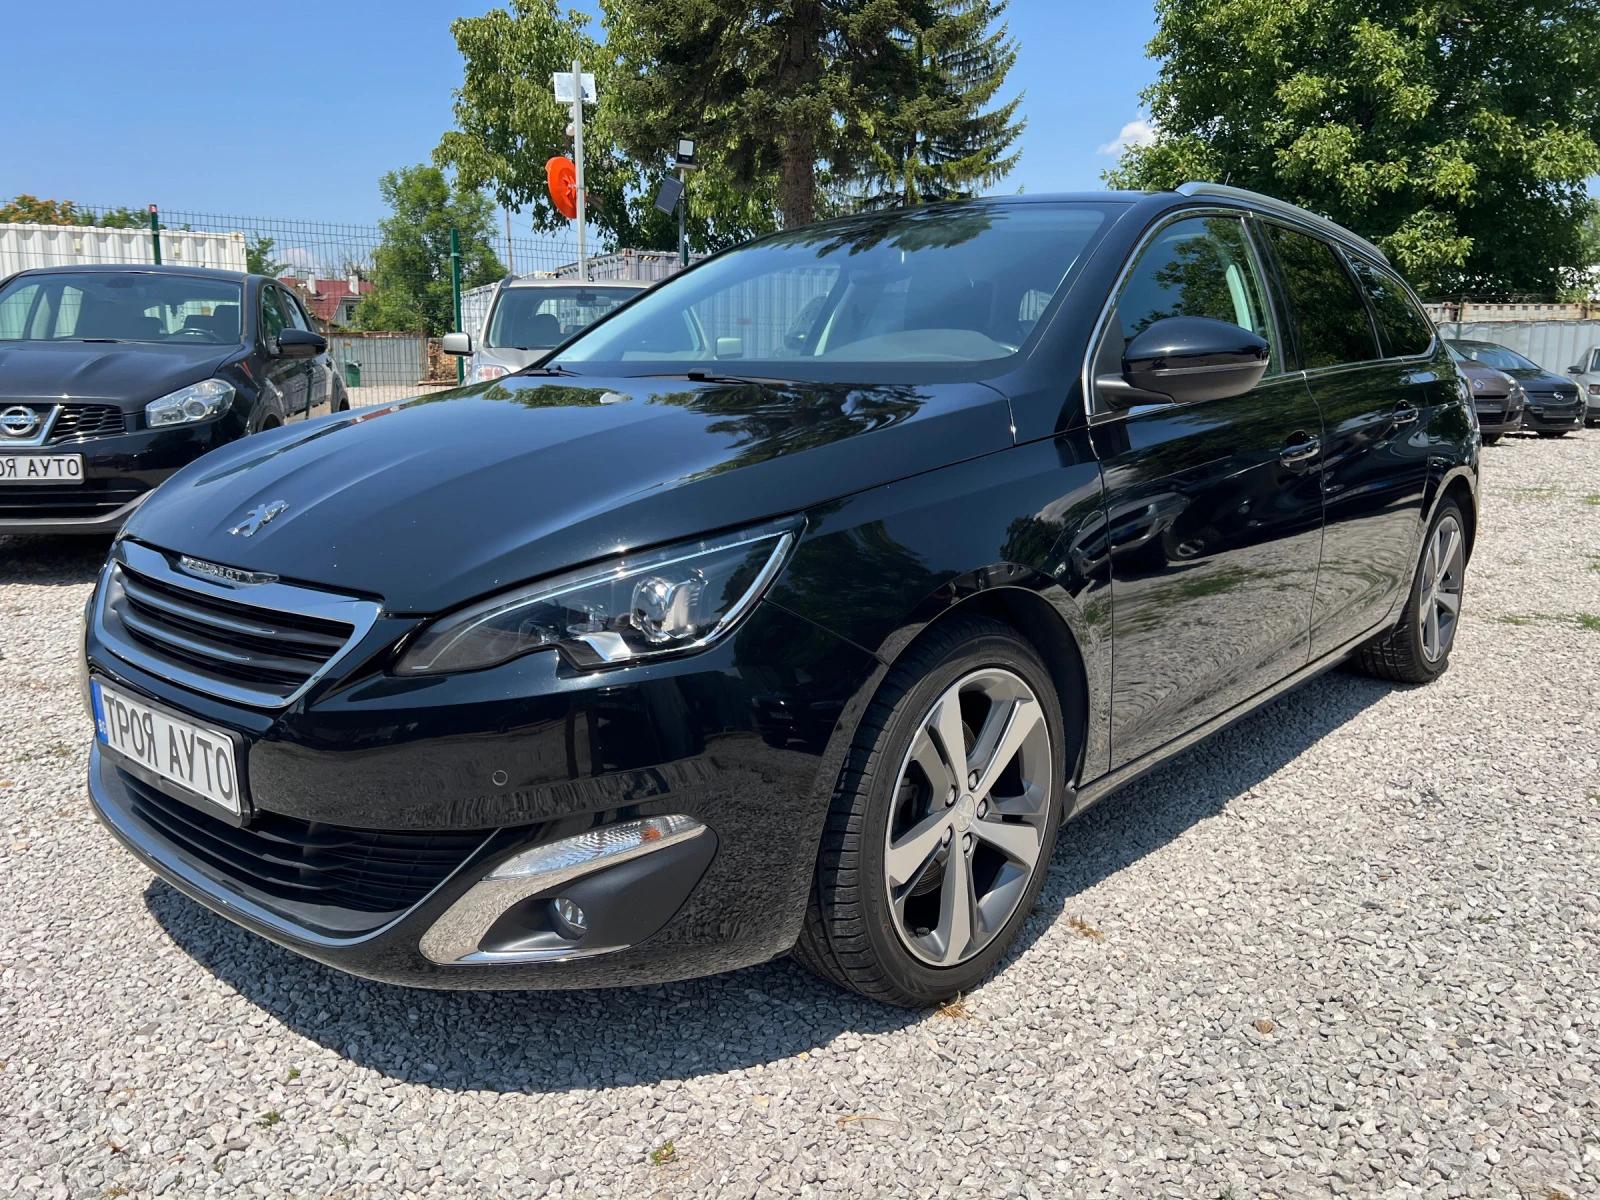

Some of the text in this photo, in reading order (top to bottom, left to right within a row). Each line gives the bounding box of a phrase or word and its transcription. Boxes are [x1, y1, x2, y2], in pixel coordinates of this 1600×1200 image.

[28, 459, 79, 477] АУТО
[104, 693, 233, 801] ТРОЯ АУТО
